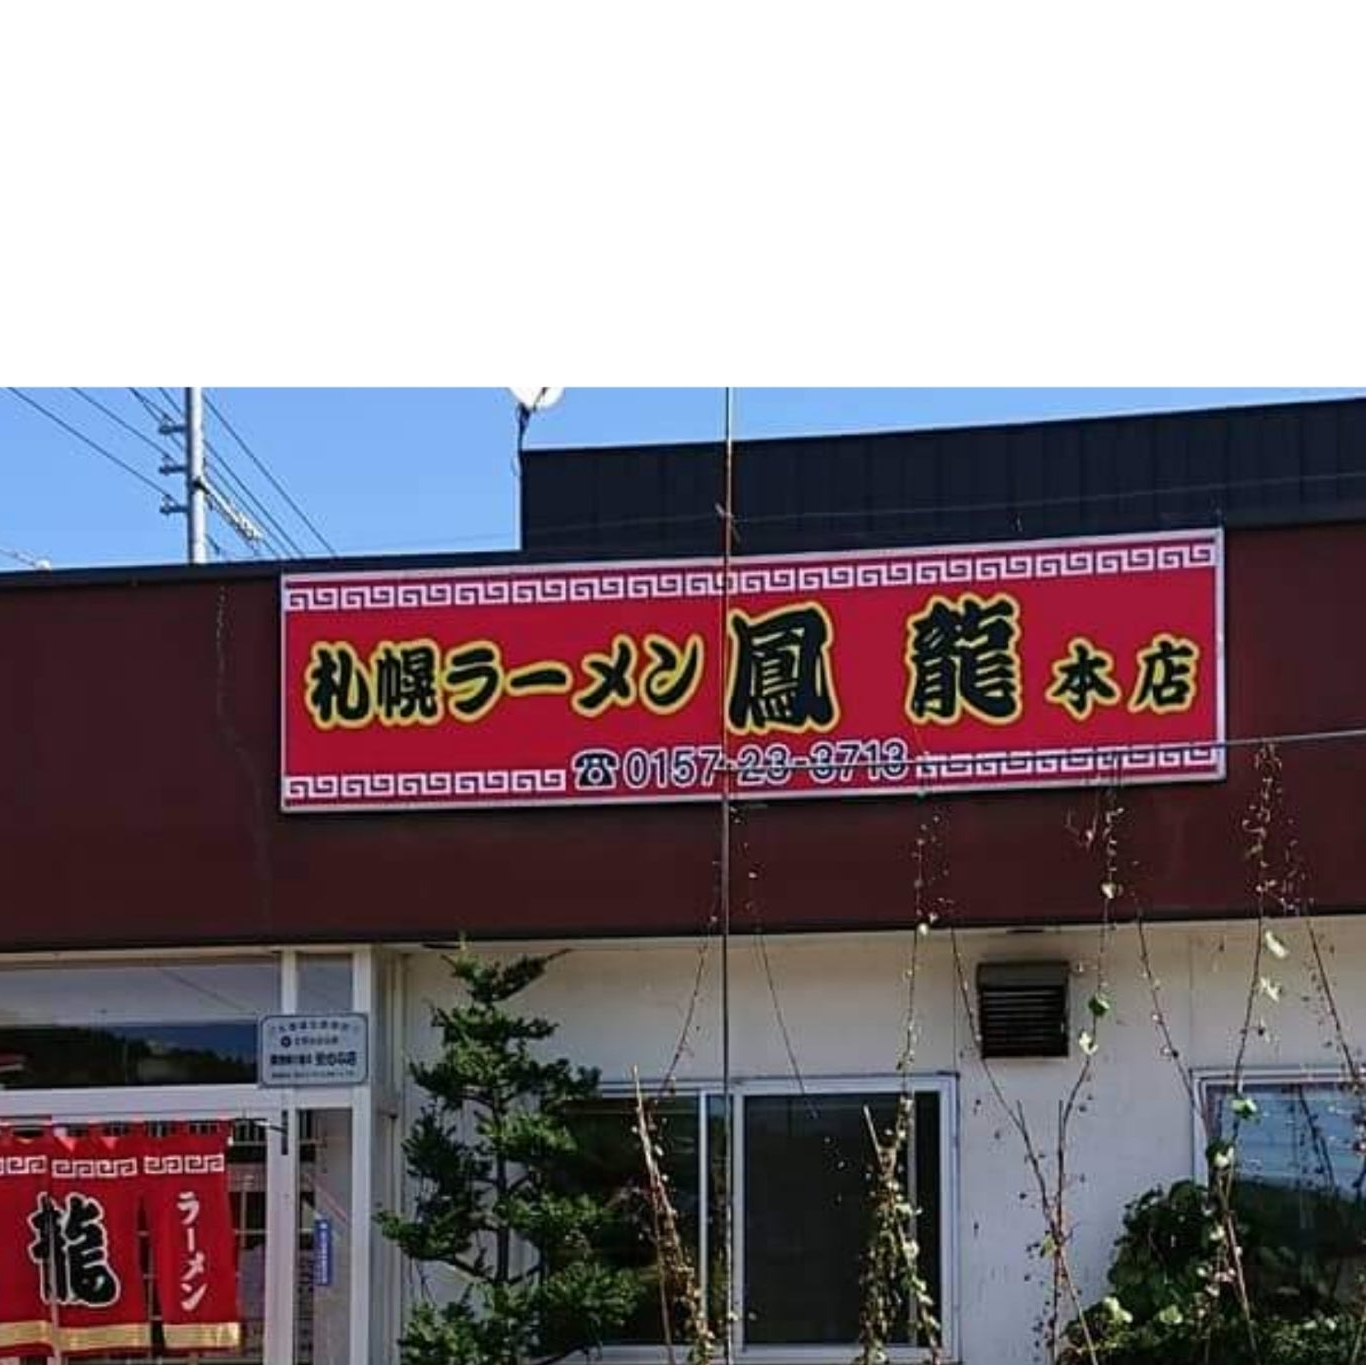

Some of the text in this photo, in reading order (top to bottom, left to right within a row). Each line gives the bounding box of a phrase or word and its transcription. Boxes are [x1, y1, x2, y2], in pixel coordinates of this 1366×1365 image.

[307, 637, 705, 729] 札幌ラーメン
[1046, 636, 1198, 719] 本店
[622, 736, 908, 789] 0157-23-3713
[177, 1191, 208, 1310] ラーメン
